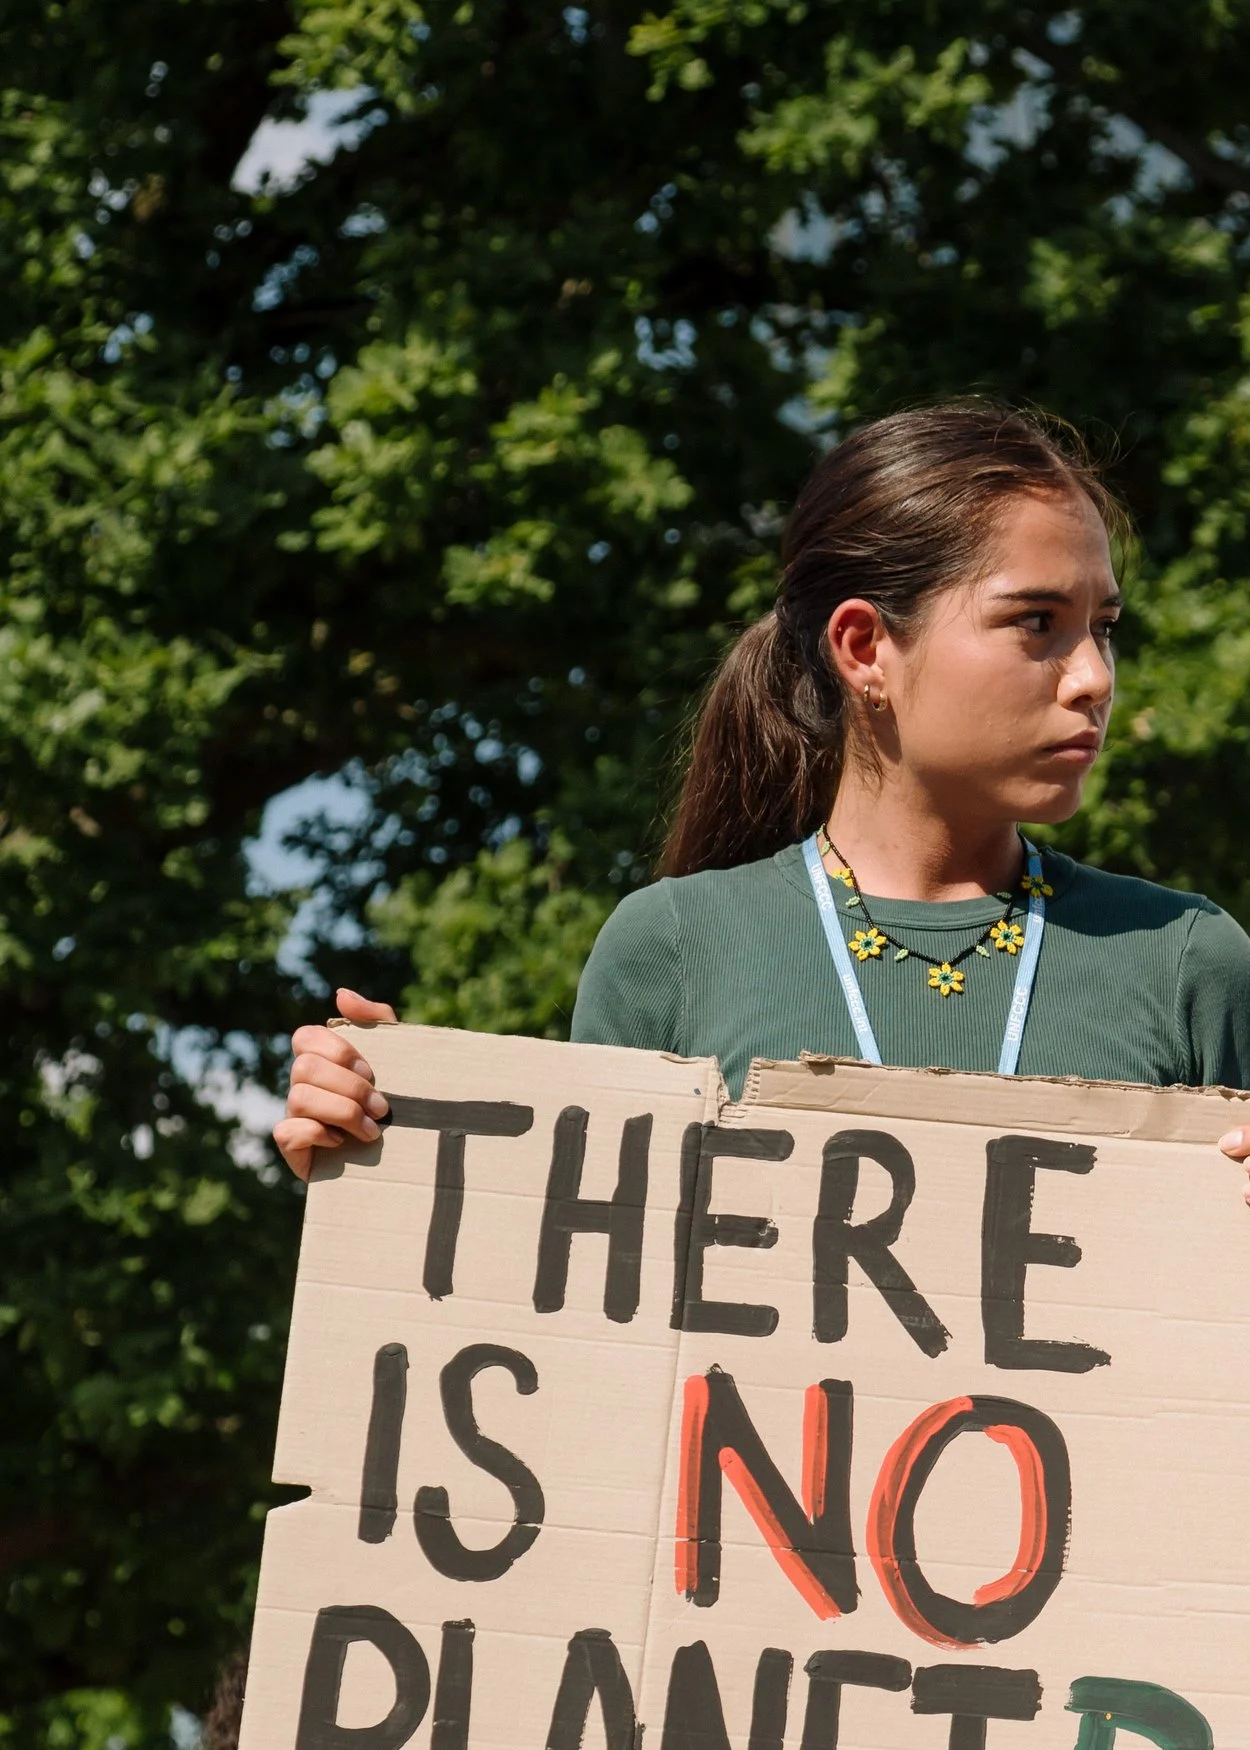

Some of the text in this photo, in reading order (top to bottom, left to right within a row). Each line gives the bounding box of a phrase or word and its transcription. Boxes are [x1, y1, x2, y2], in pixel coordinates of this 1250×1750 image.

[811, 863, 834, 911] UNFCCC
[1007, 986, 1030, 1042] UNFCCC
[376, 1090, 1112, 1374] THERE
[357, 1342, 1072, 1652] IS NO
